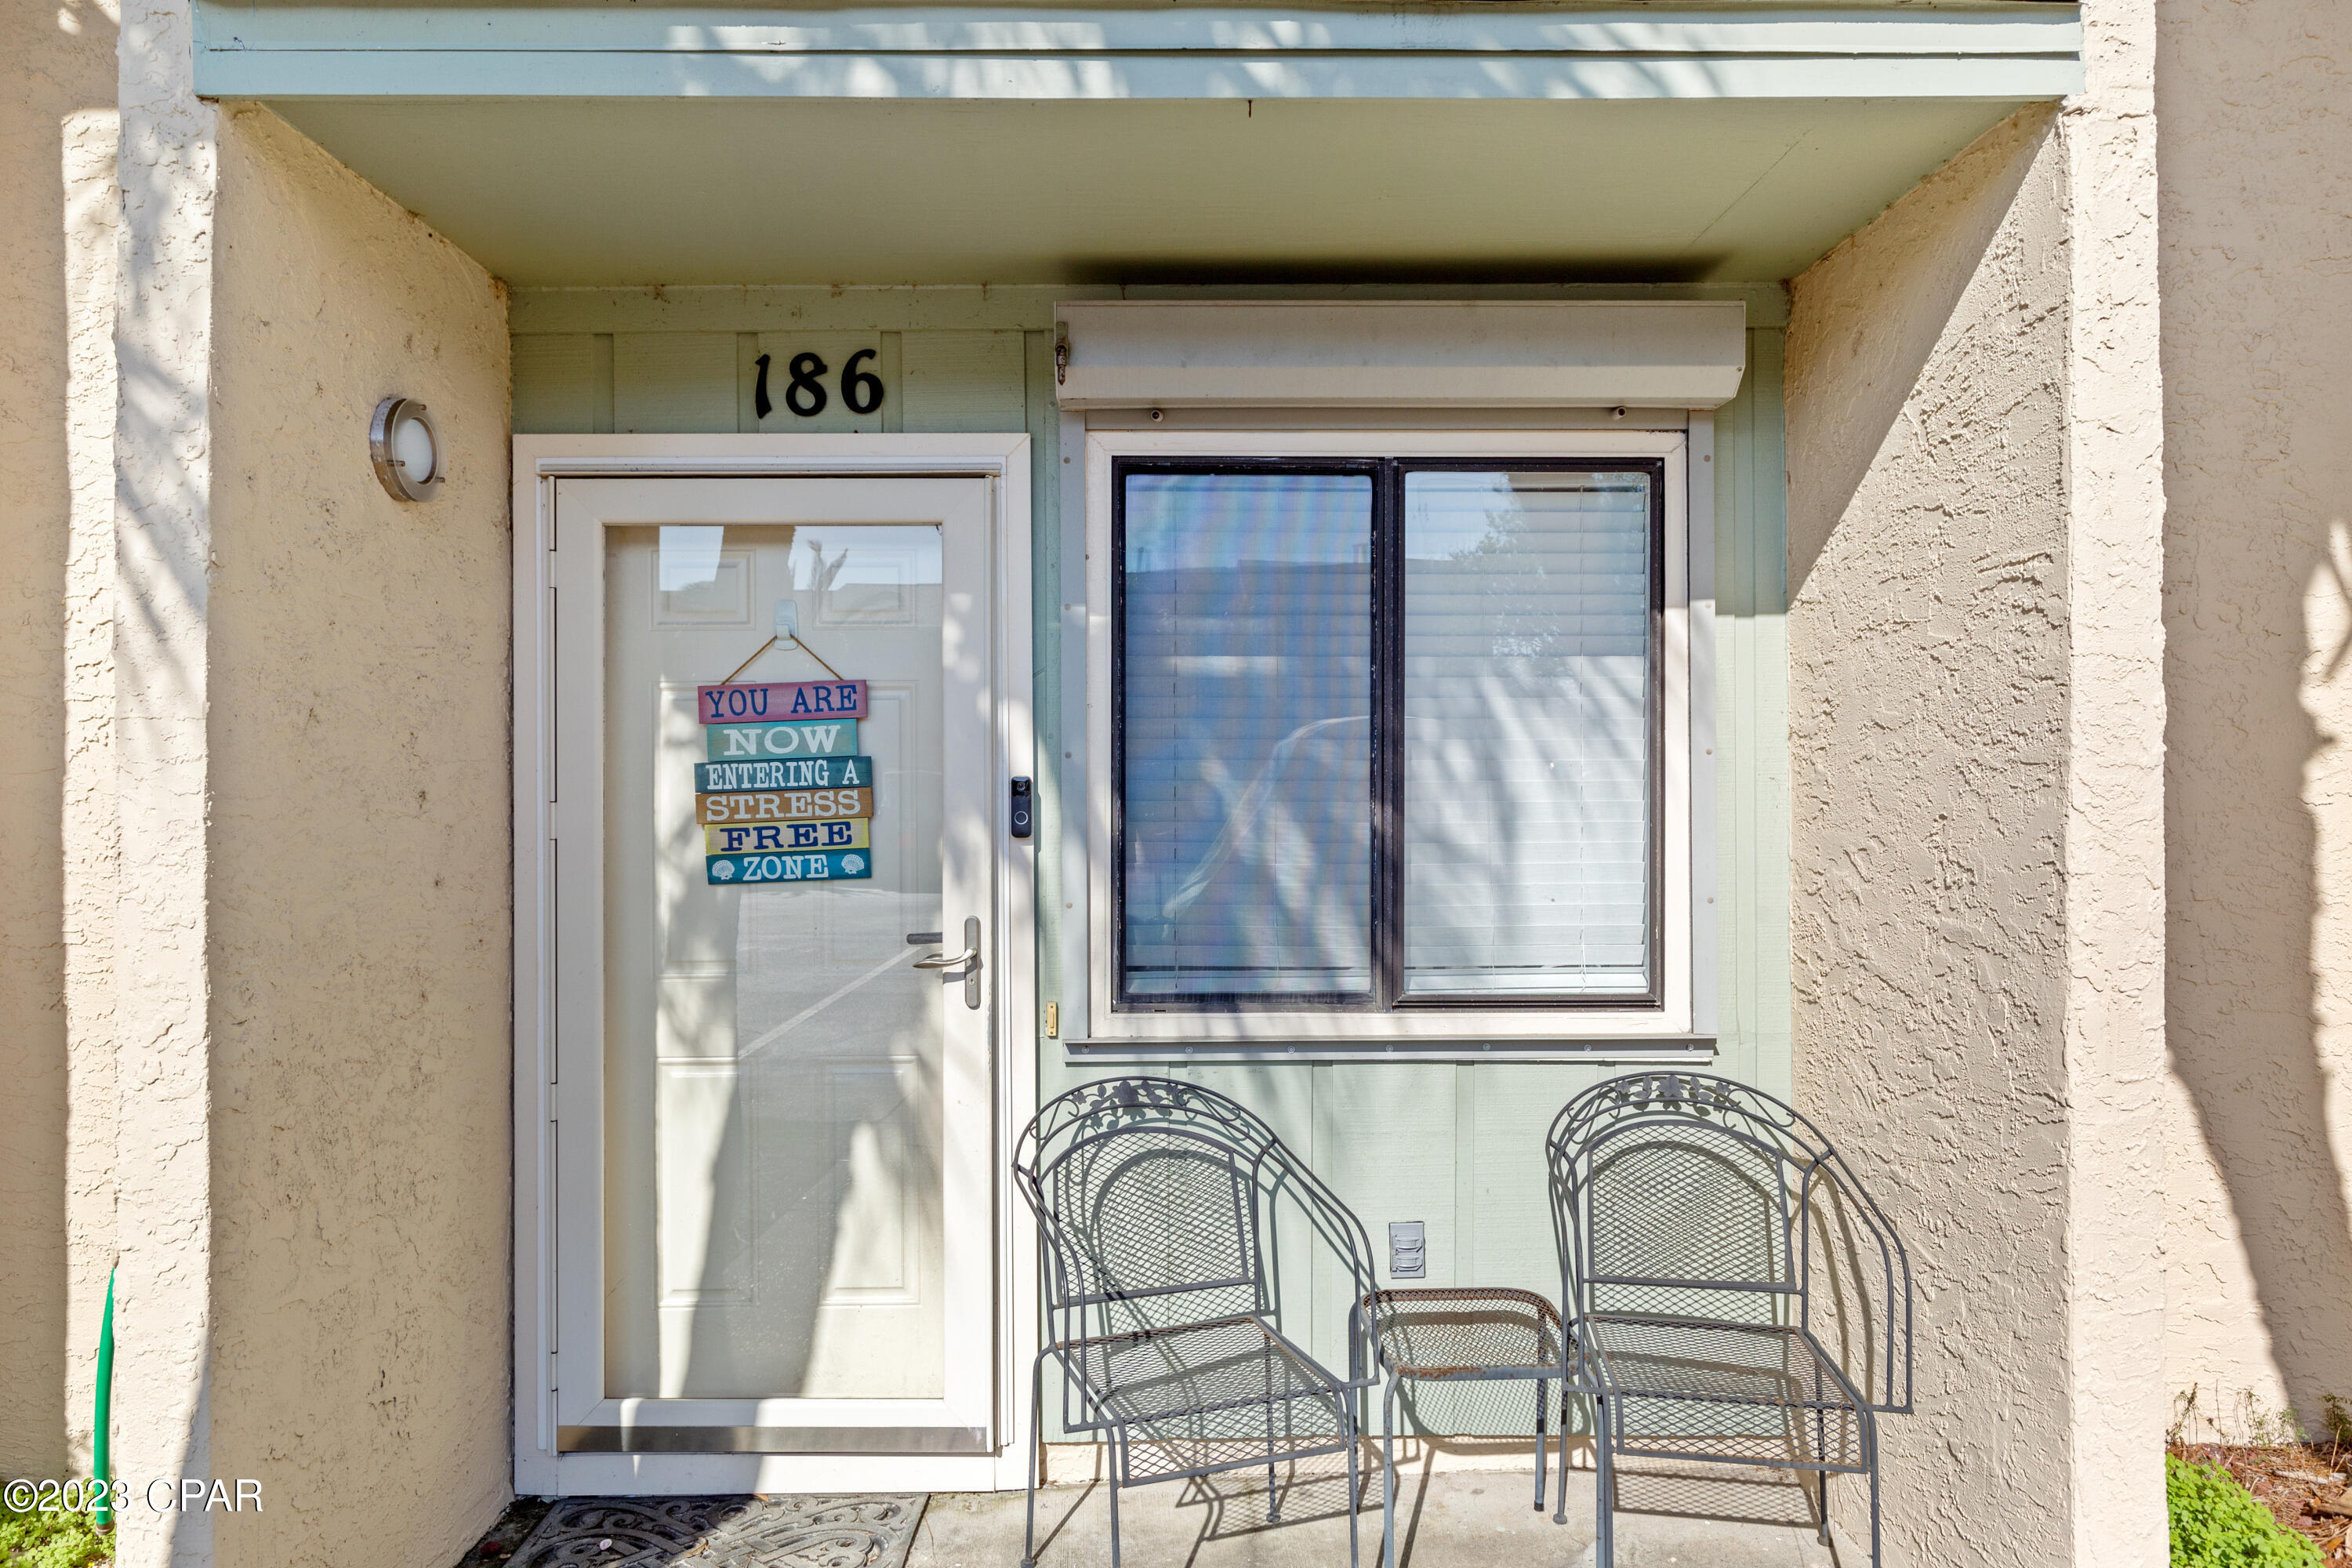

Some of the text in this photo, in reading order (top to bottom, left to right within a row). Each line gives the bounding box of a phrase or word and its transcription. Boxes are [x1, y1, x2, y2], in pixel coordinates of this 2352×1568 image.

[755, 349, 884, 419] 186
[705, 684, 858, 718] YOU ARE
[723, 724, 841, 755] NOW
[706, 759, 860, 789] ENTERING A
[706, 789, 861, 822] STRESS
[720, 821, 853, 851] FREE
[742, 855, 829, 880] ZONE
